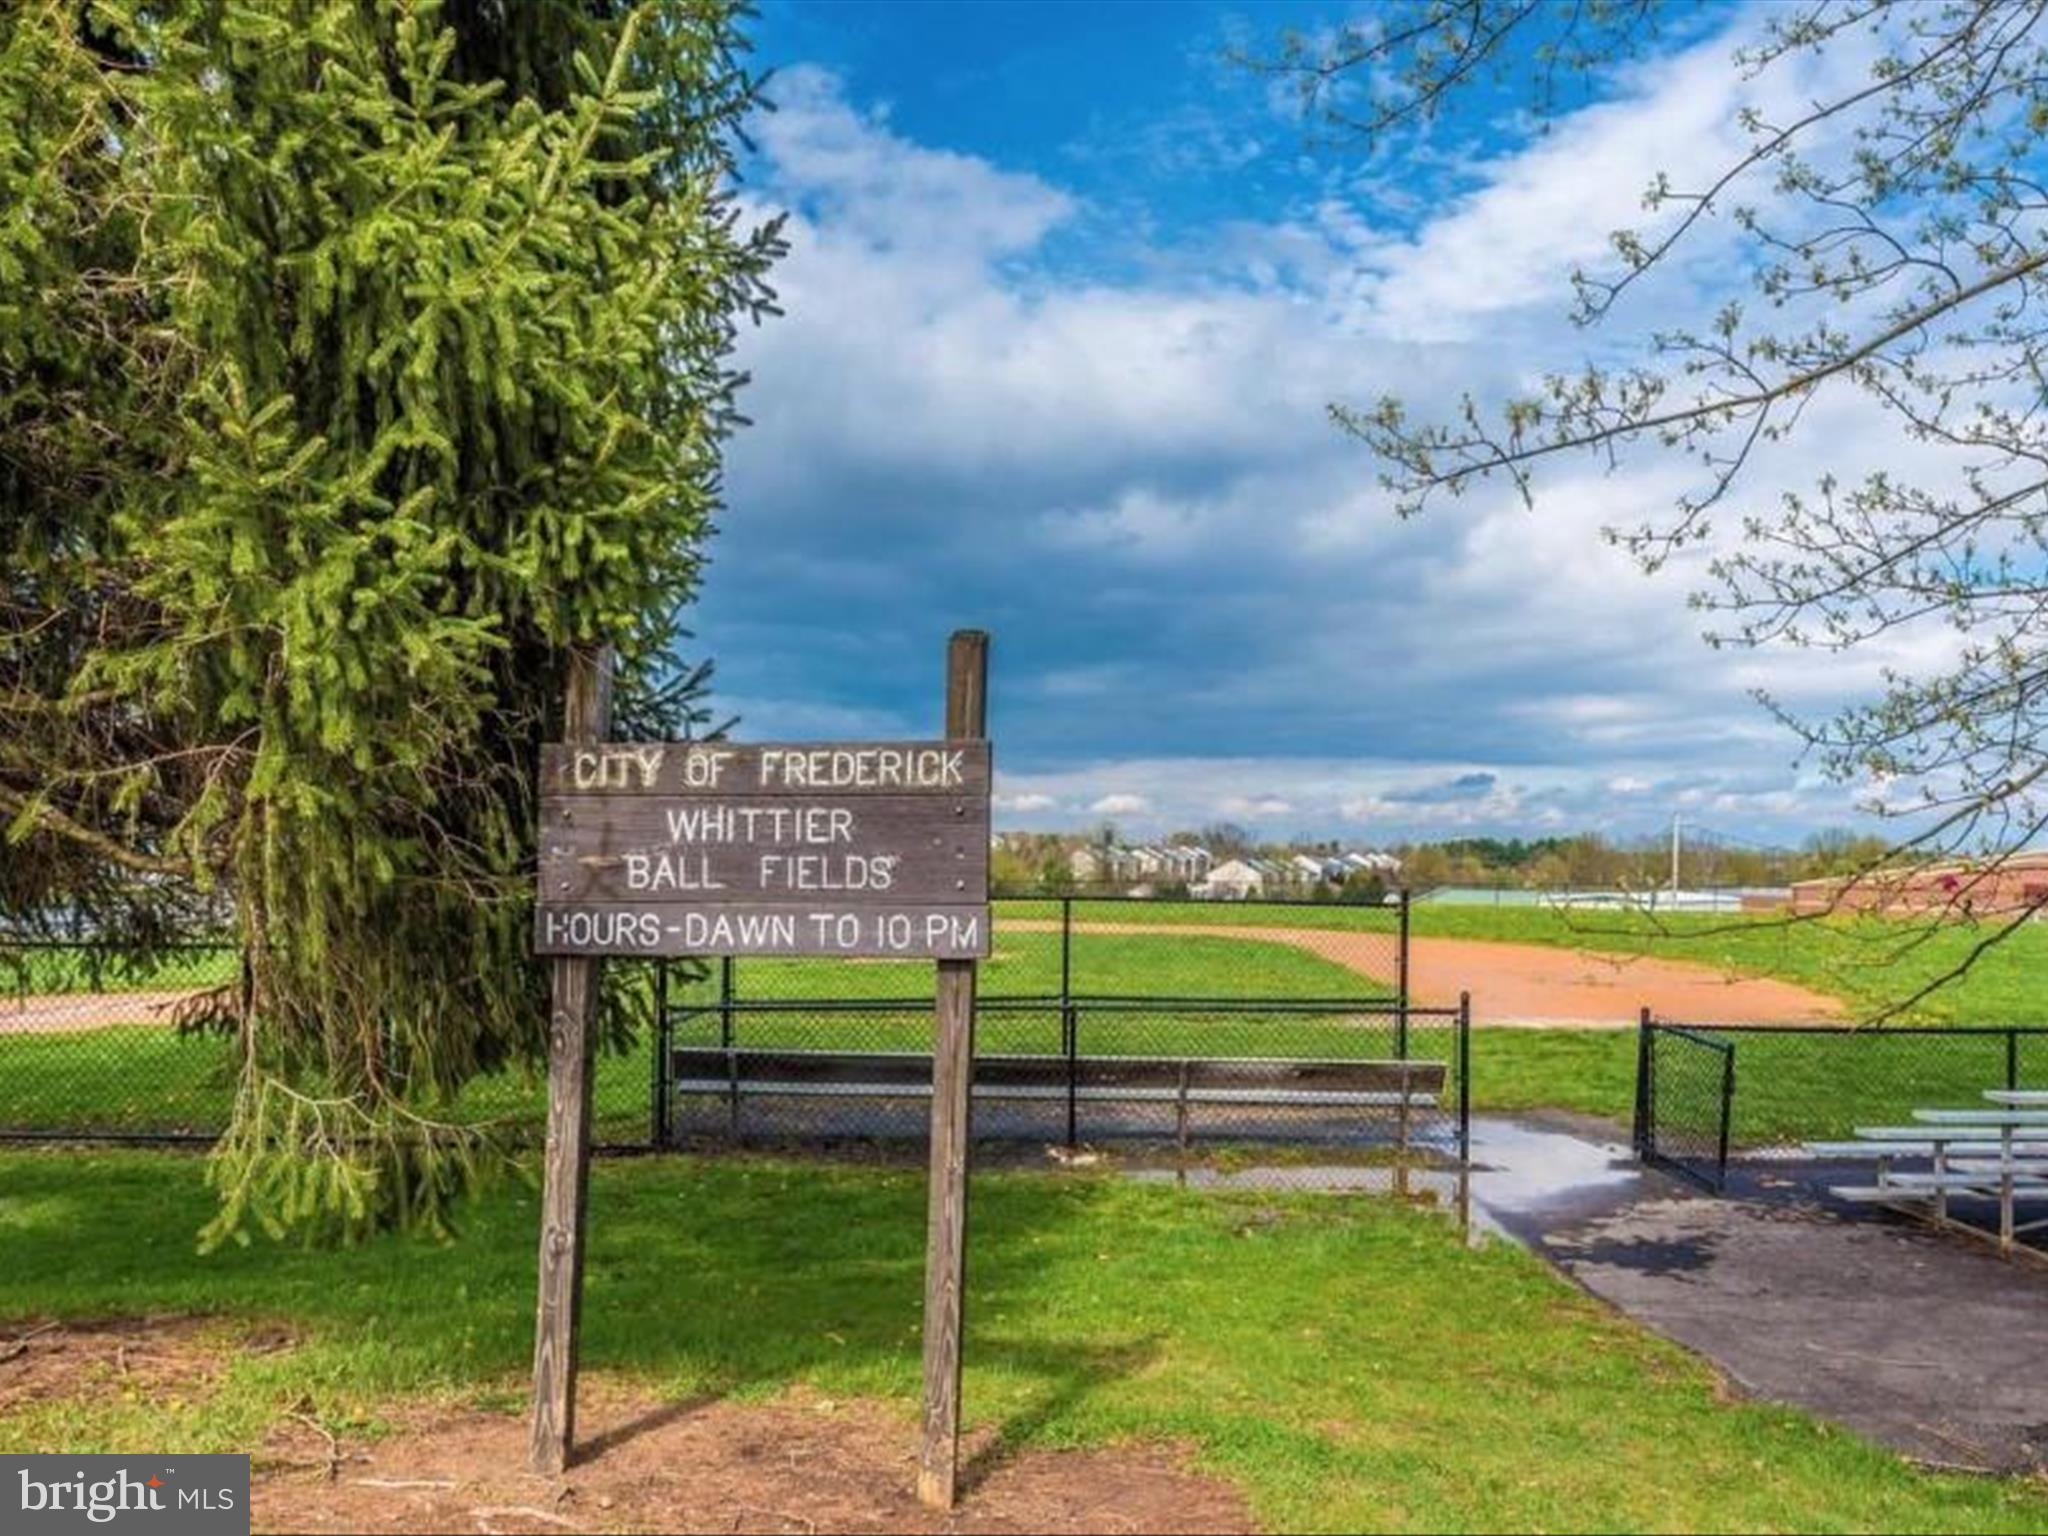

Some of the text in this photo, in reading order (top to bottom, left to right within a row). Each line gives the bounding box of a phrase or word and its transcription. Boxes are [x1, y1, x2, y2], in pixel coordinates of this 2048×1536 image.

[573, 750, 965, 789] CITY OF FREDERICK
[667, 808, 853, 843] WHITTIER
[627, 855, 896, 890] BALL FIELDS
[809, 914, 860, 947] TO
[877, 914, 911, 947] 10
[926, 914, 978, 948] PM
